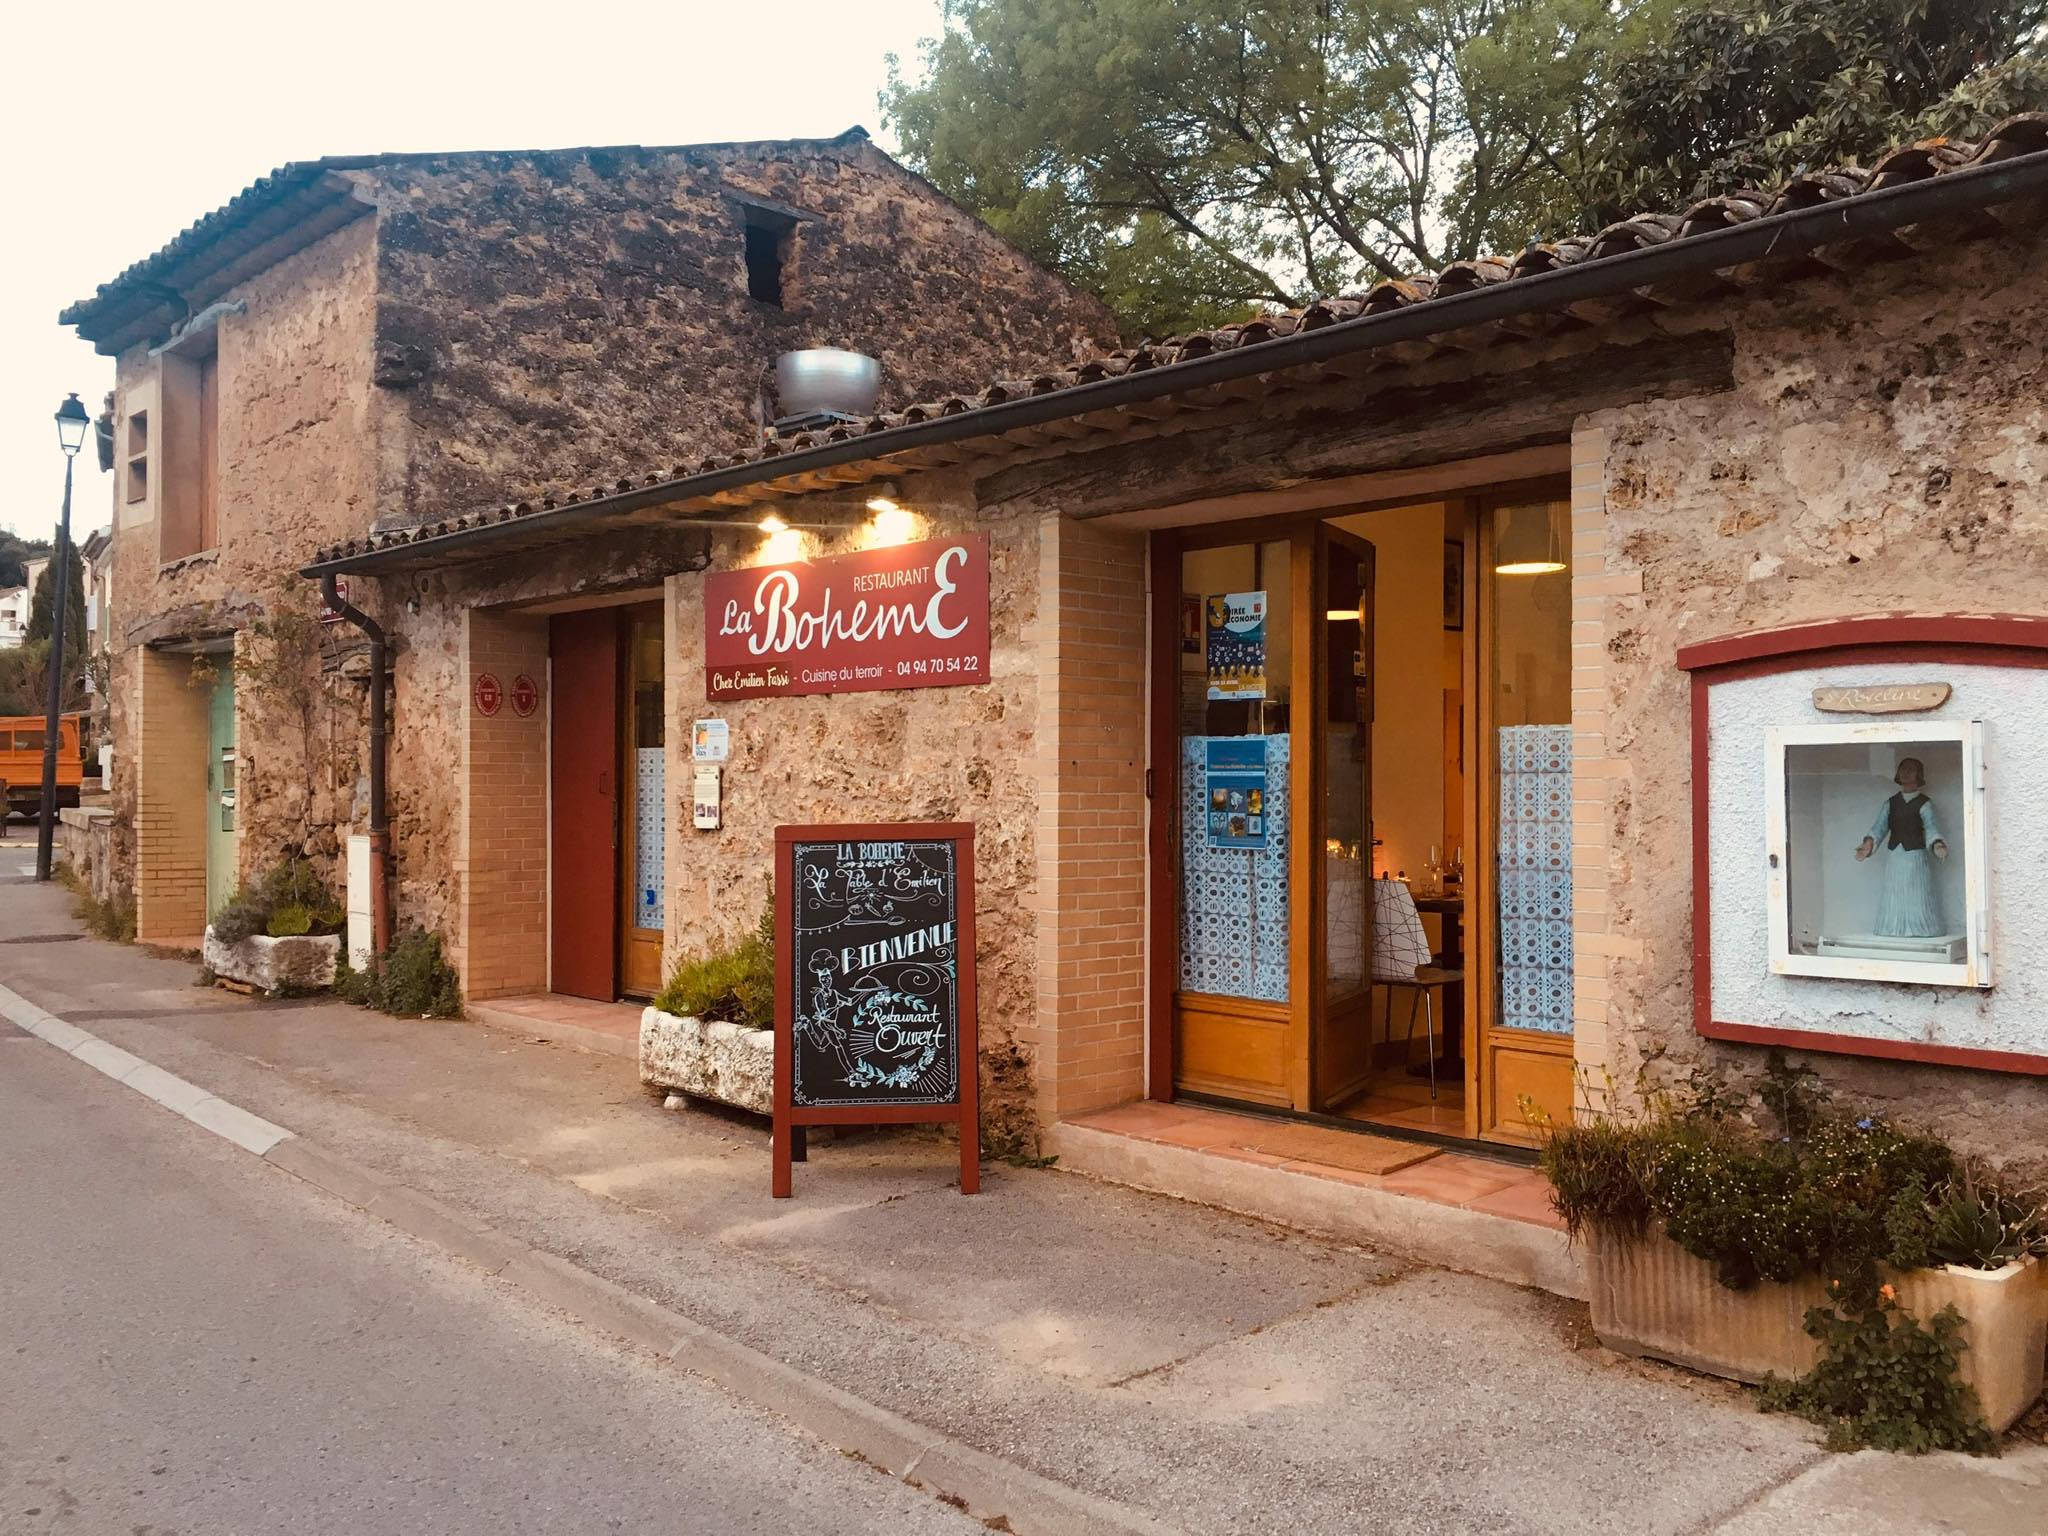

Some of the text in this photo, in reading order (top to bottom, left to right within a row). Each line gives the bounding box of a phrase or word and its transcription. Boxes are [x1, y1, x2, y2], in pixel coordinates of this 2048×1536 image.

[853, 566, 931, 593] RESTAURANT
[719, 599, 752, 636] La
[713, 656, 978, 691] Chez Emilien Fassi Cuisine du terroir 04 94 70 54 22
[836, 844, 854, 861] LA
[804, 864, 831, 901] La
[835, 868, 875, 902] Table
[841, 920, 957, 975] BIENVENUE
[868, 1004, 940, 1028] Restaurant
[875, 1023, 947, 1053] Ouvert
